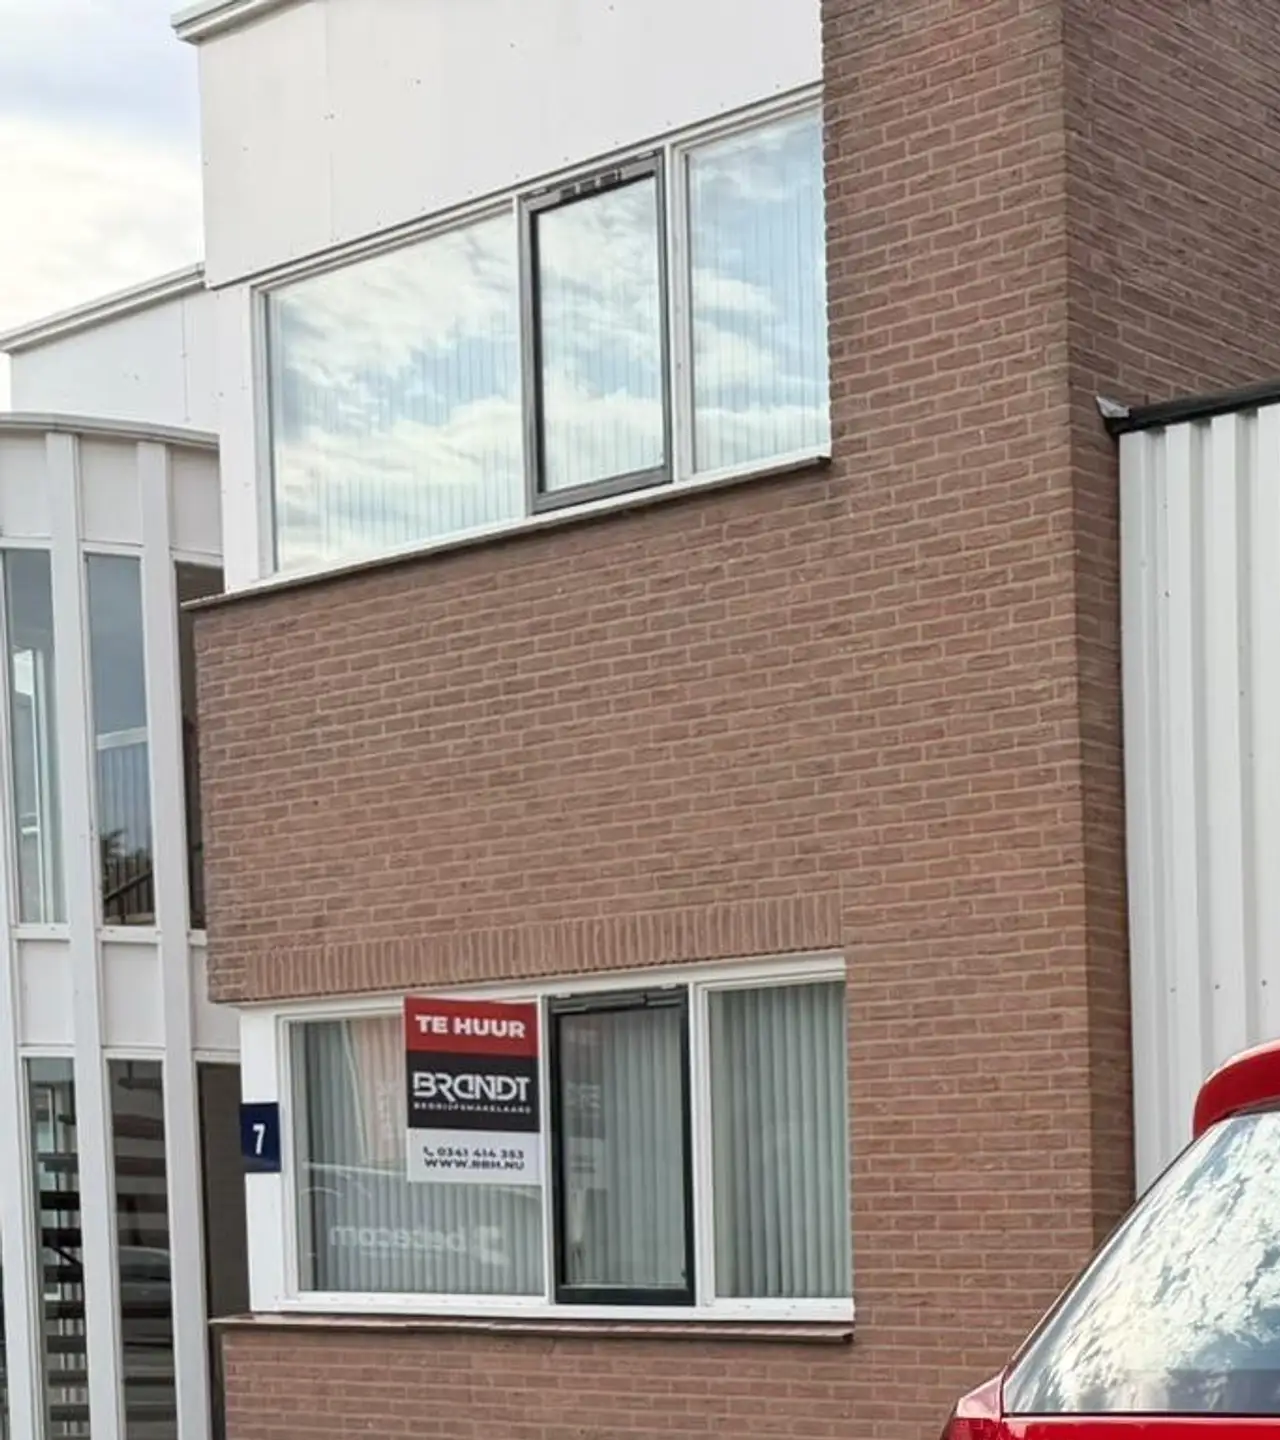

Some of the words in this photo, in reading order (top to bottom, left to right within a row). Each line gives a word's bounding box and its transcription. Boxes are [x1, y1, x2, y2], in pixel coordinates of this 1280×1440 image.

[415, 1014, 448, 1034] TE
[454, 1017, 526, 1038] HUUR
[412, 1071, 531, 1102] BRANDT
[253, 1124, 265, 1155] 7
